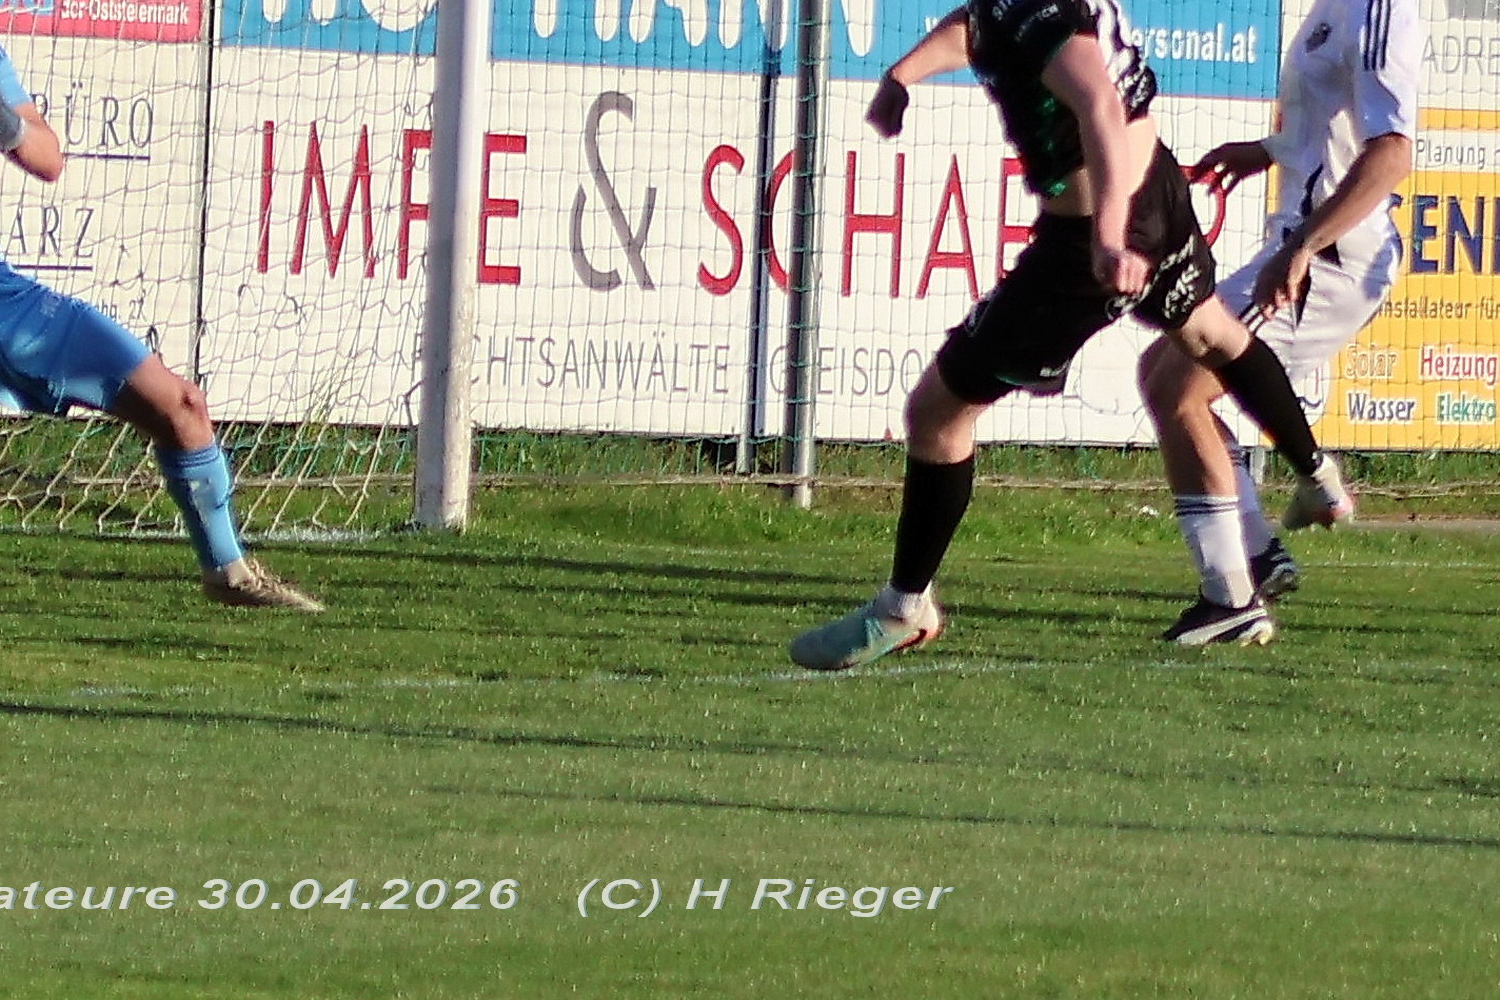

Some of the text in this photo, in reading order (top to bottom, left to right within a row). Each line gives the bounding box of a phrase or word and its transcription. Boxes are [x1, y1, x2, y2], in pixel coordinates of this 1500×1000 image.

[1415, 139, 1486, 170] Planung
[569, 90, 657, 292] &
[1347, 346, 1498, 386] Solar Heizung
[1348, 394, 1496, 421] Wasser Elektro
